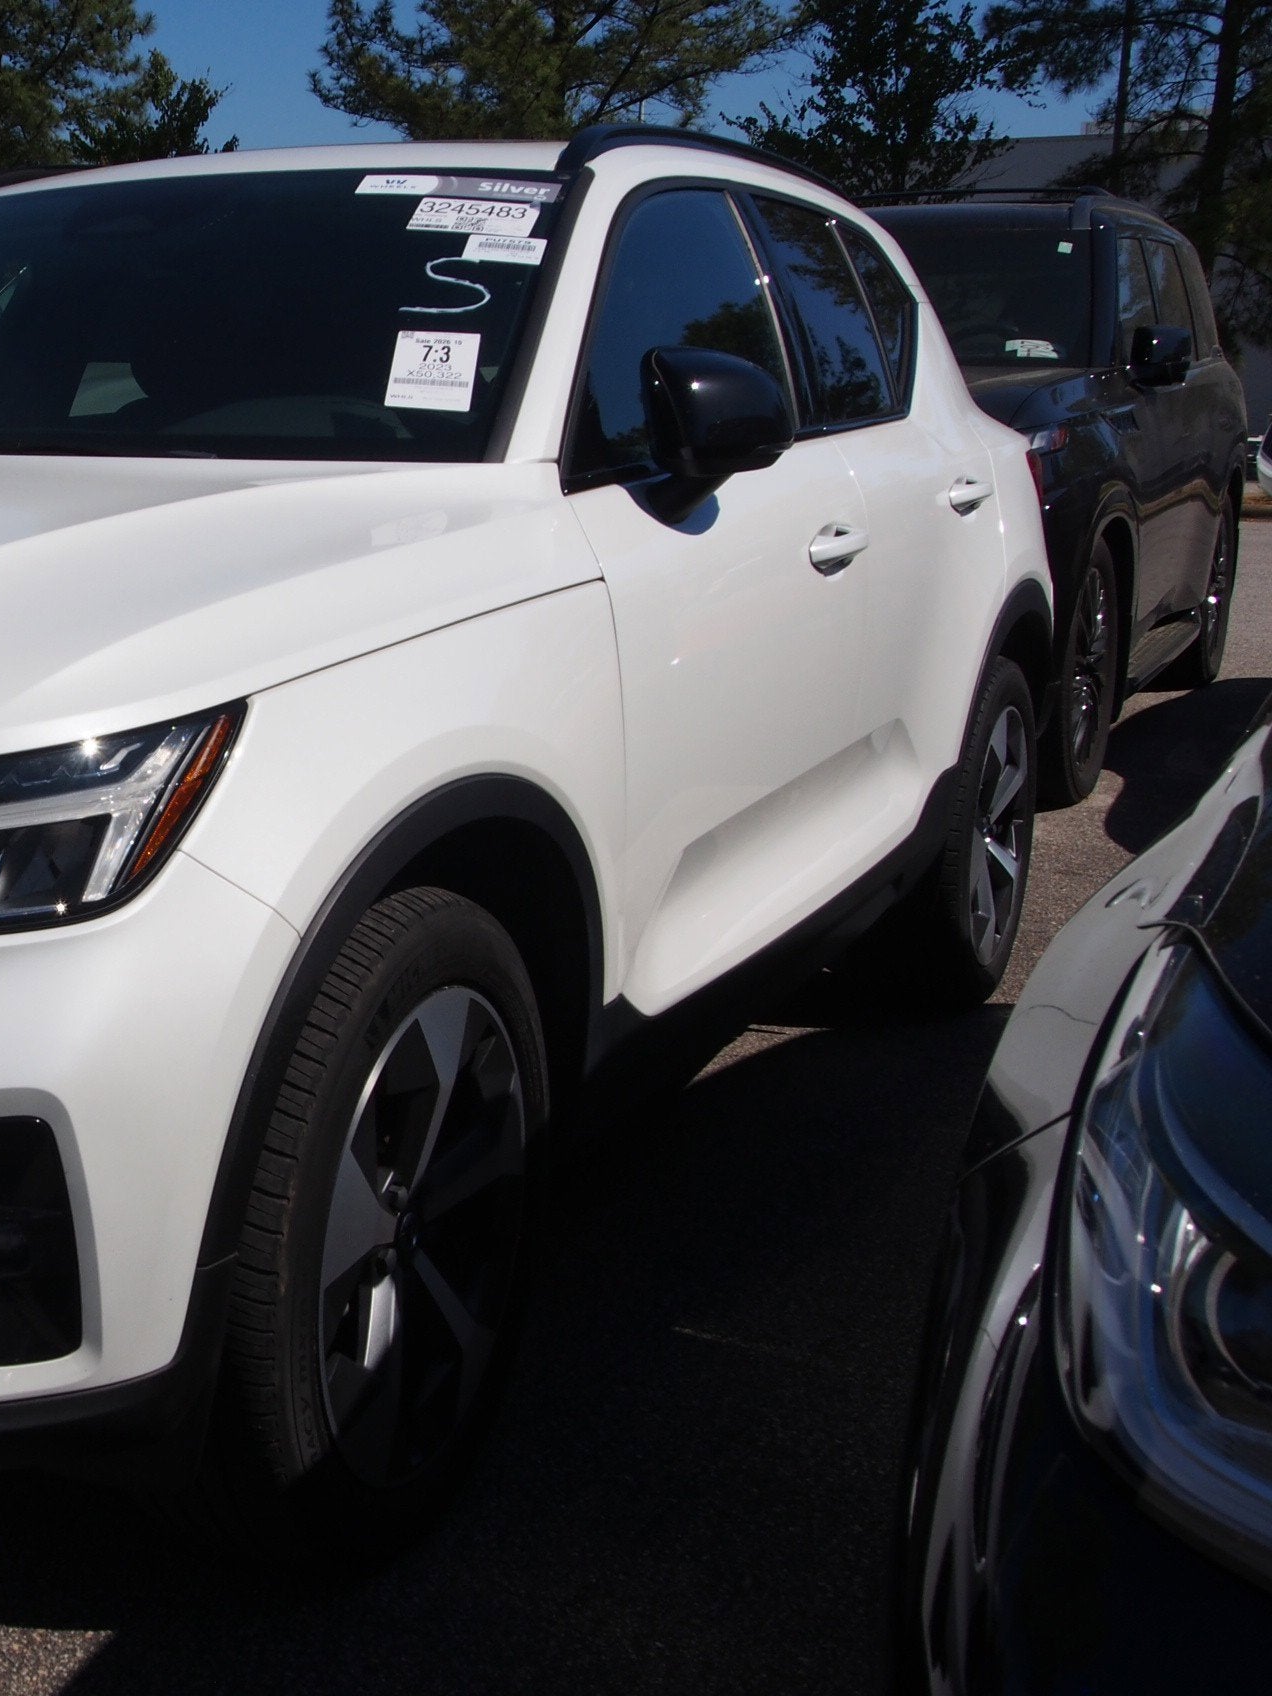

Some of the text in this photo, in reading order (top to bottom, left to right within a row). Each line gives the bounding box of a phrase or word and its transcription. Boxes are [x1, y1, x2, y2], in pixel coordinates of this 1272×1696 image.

[478, 181, 551, 196] Silver
[419, 200, 528, 220] 3245483
[421, 345, 451, 363] 7:3
[418, 362, 453, 371] 2023
